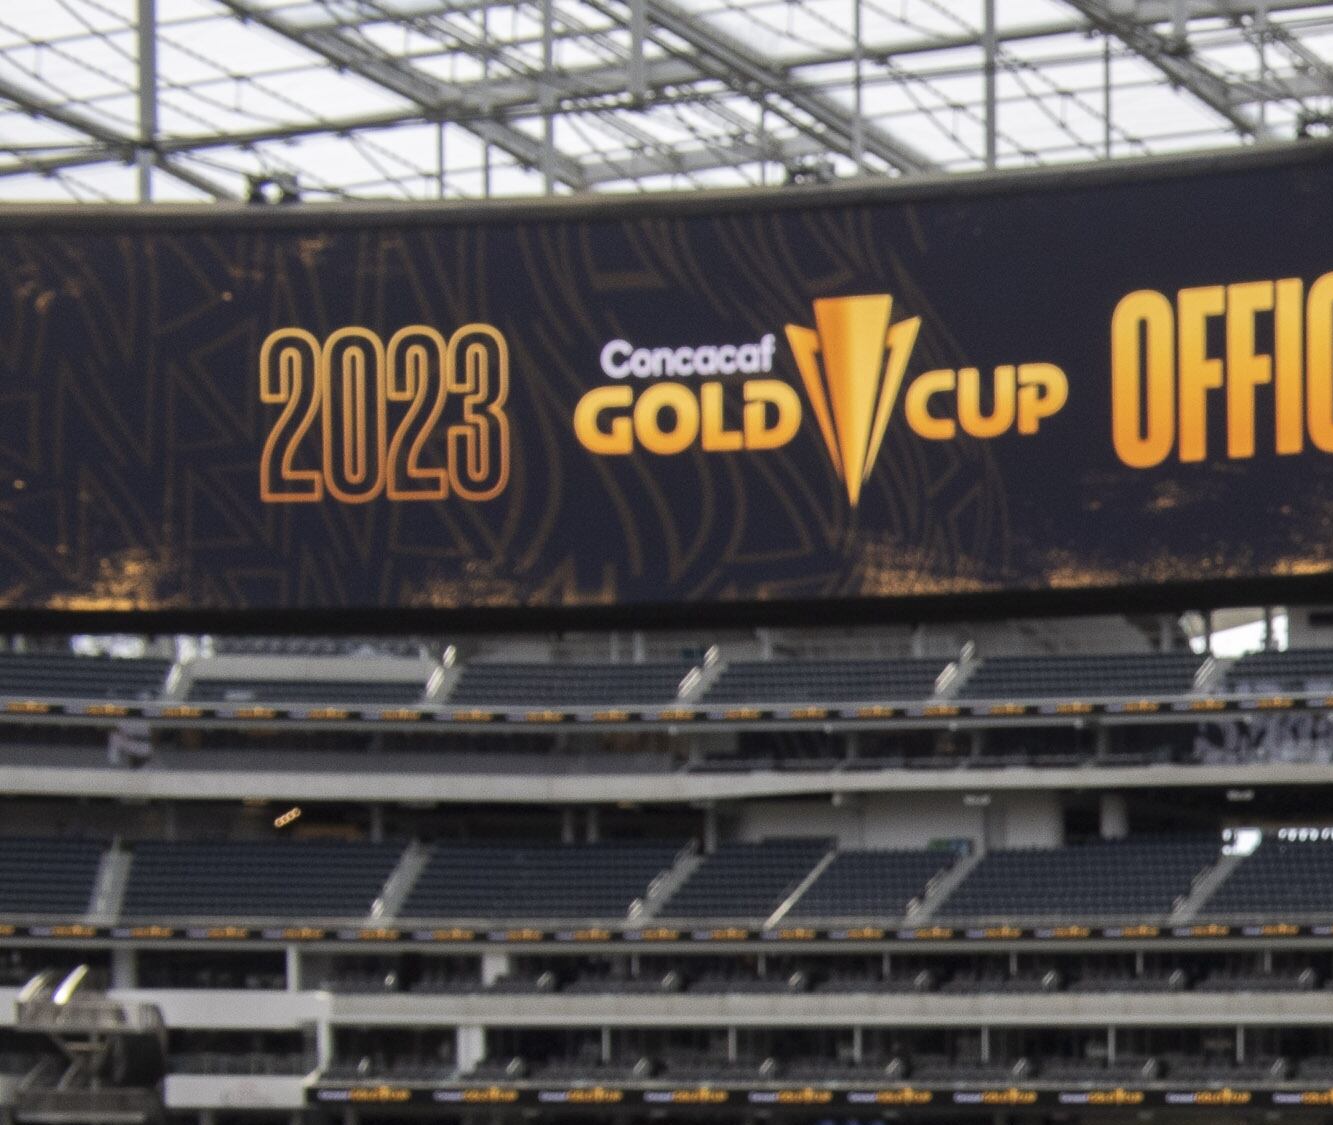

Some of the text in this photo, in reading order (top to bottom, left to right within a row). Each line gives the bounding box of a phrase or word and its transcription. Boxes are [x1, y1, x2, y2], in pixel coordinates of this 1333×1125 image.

[600, 333, 776, 379] Concacaf
[259, 322, 510, 504] 2023
[573, 362, 1069, 456] GOLD CUP
